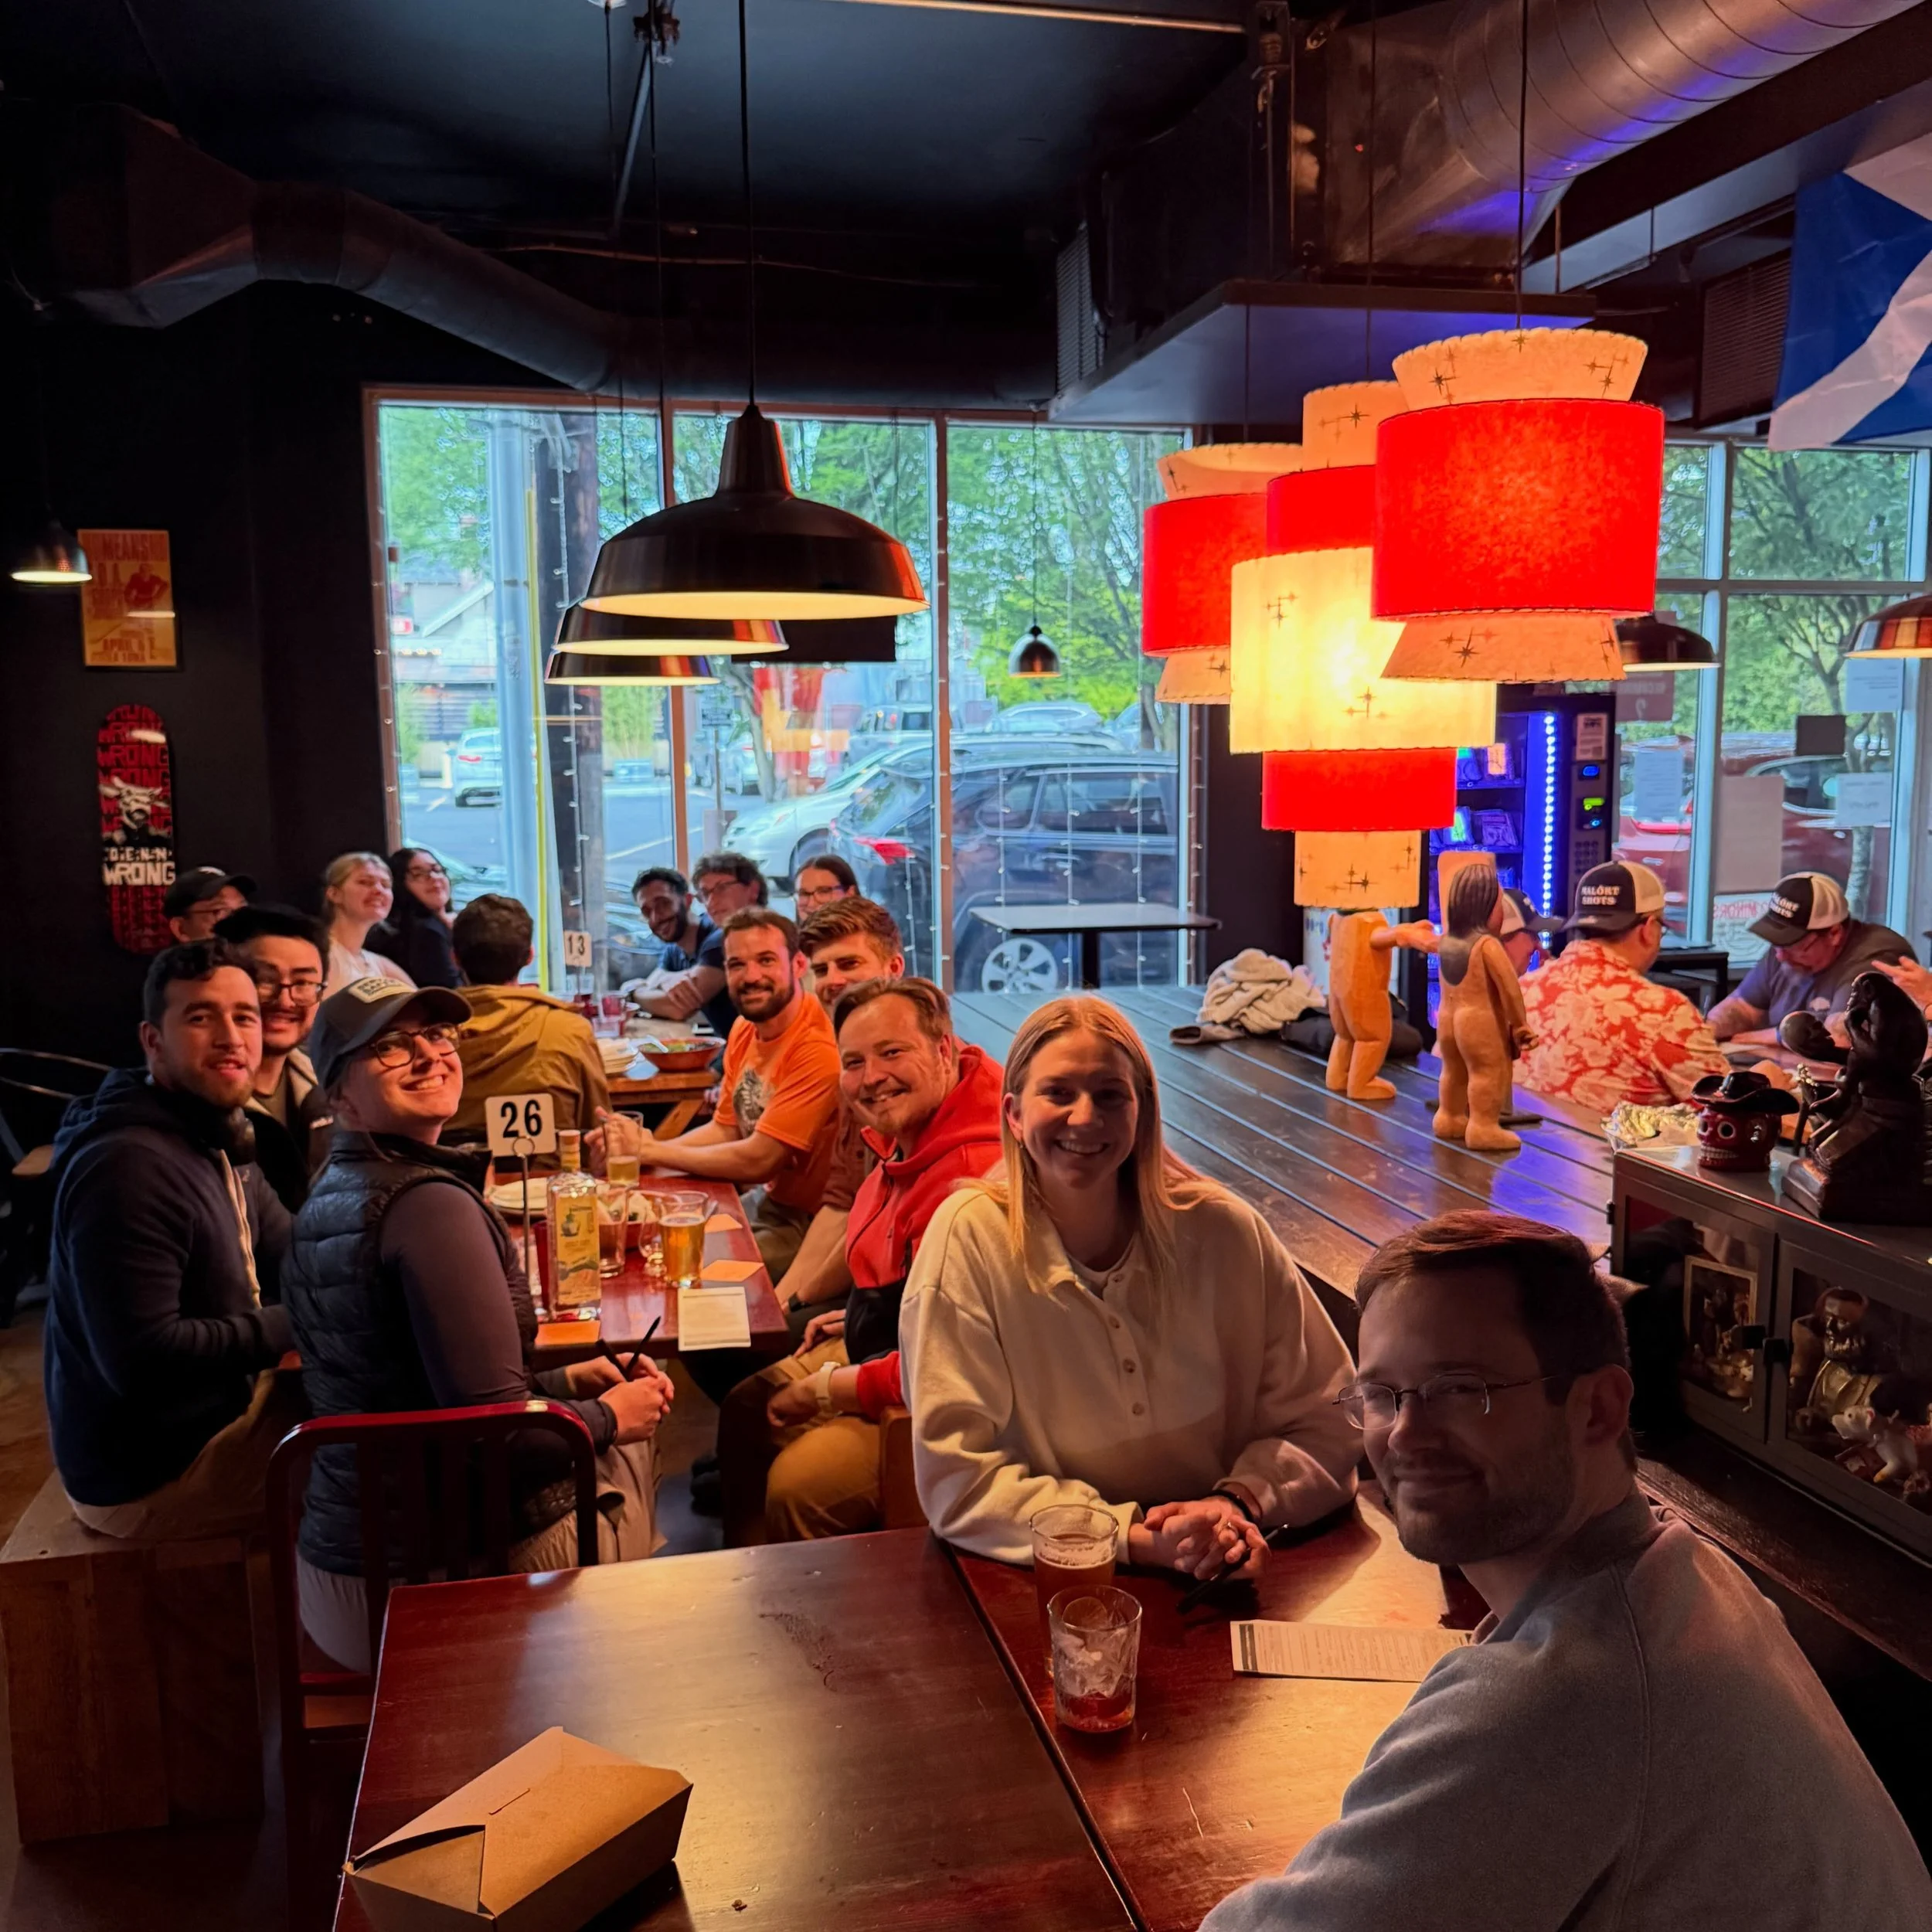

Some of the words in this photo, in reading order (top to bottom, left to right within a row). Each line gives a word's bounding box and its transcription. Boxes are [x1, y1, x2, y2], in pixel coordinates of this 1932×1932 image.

[97, 745, 168, 767] WRONG
[103, 862, 176, 886] WRONG
[569, 934, 586, 955] 13
[500, 1099, 543, 1138] 26
